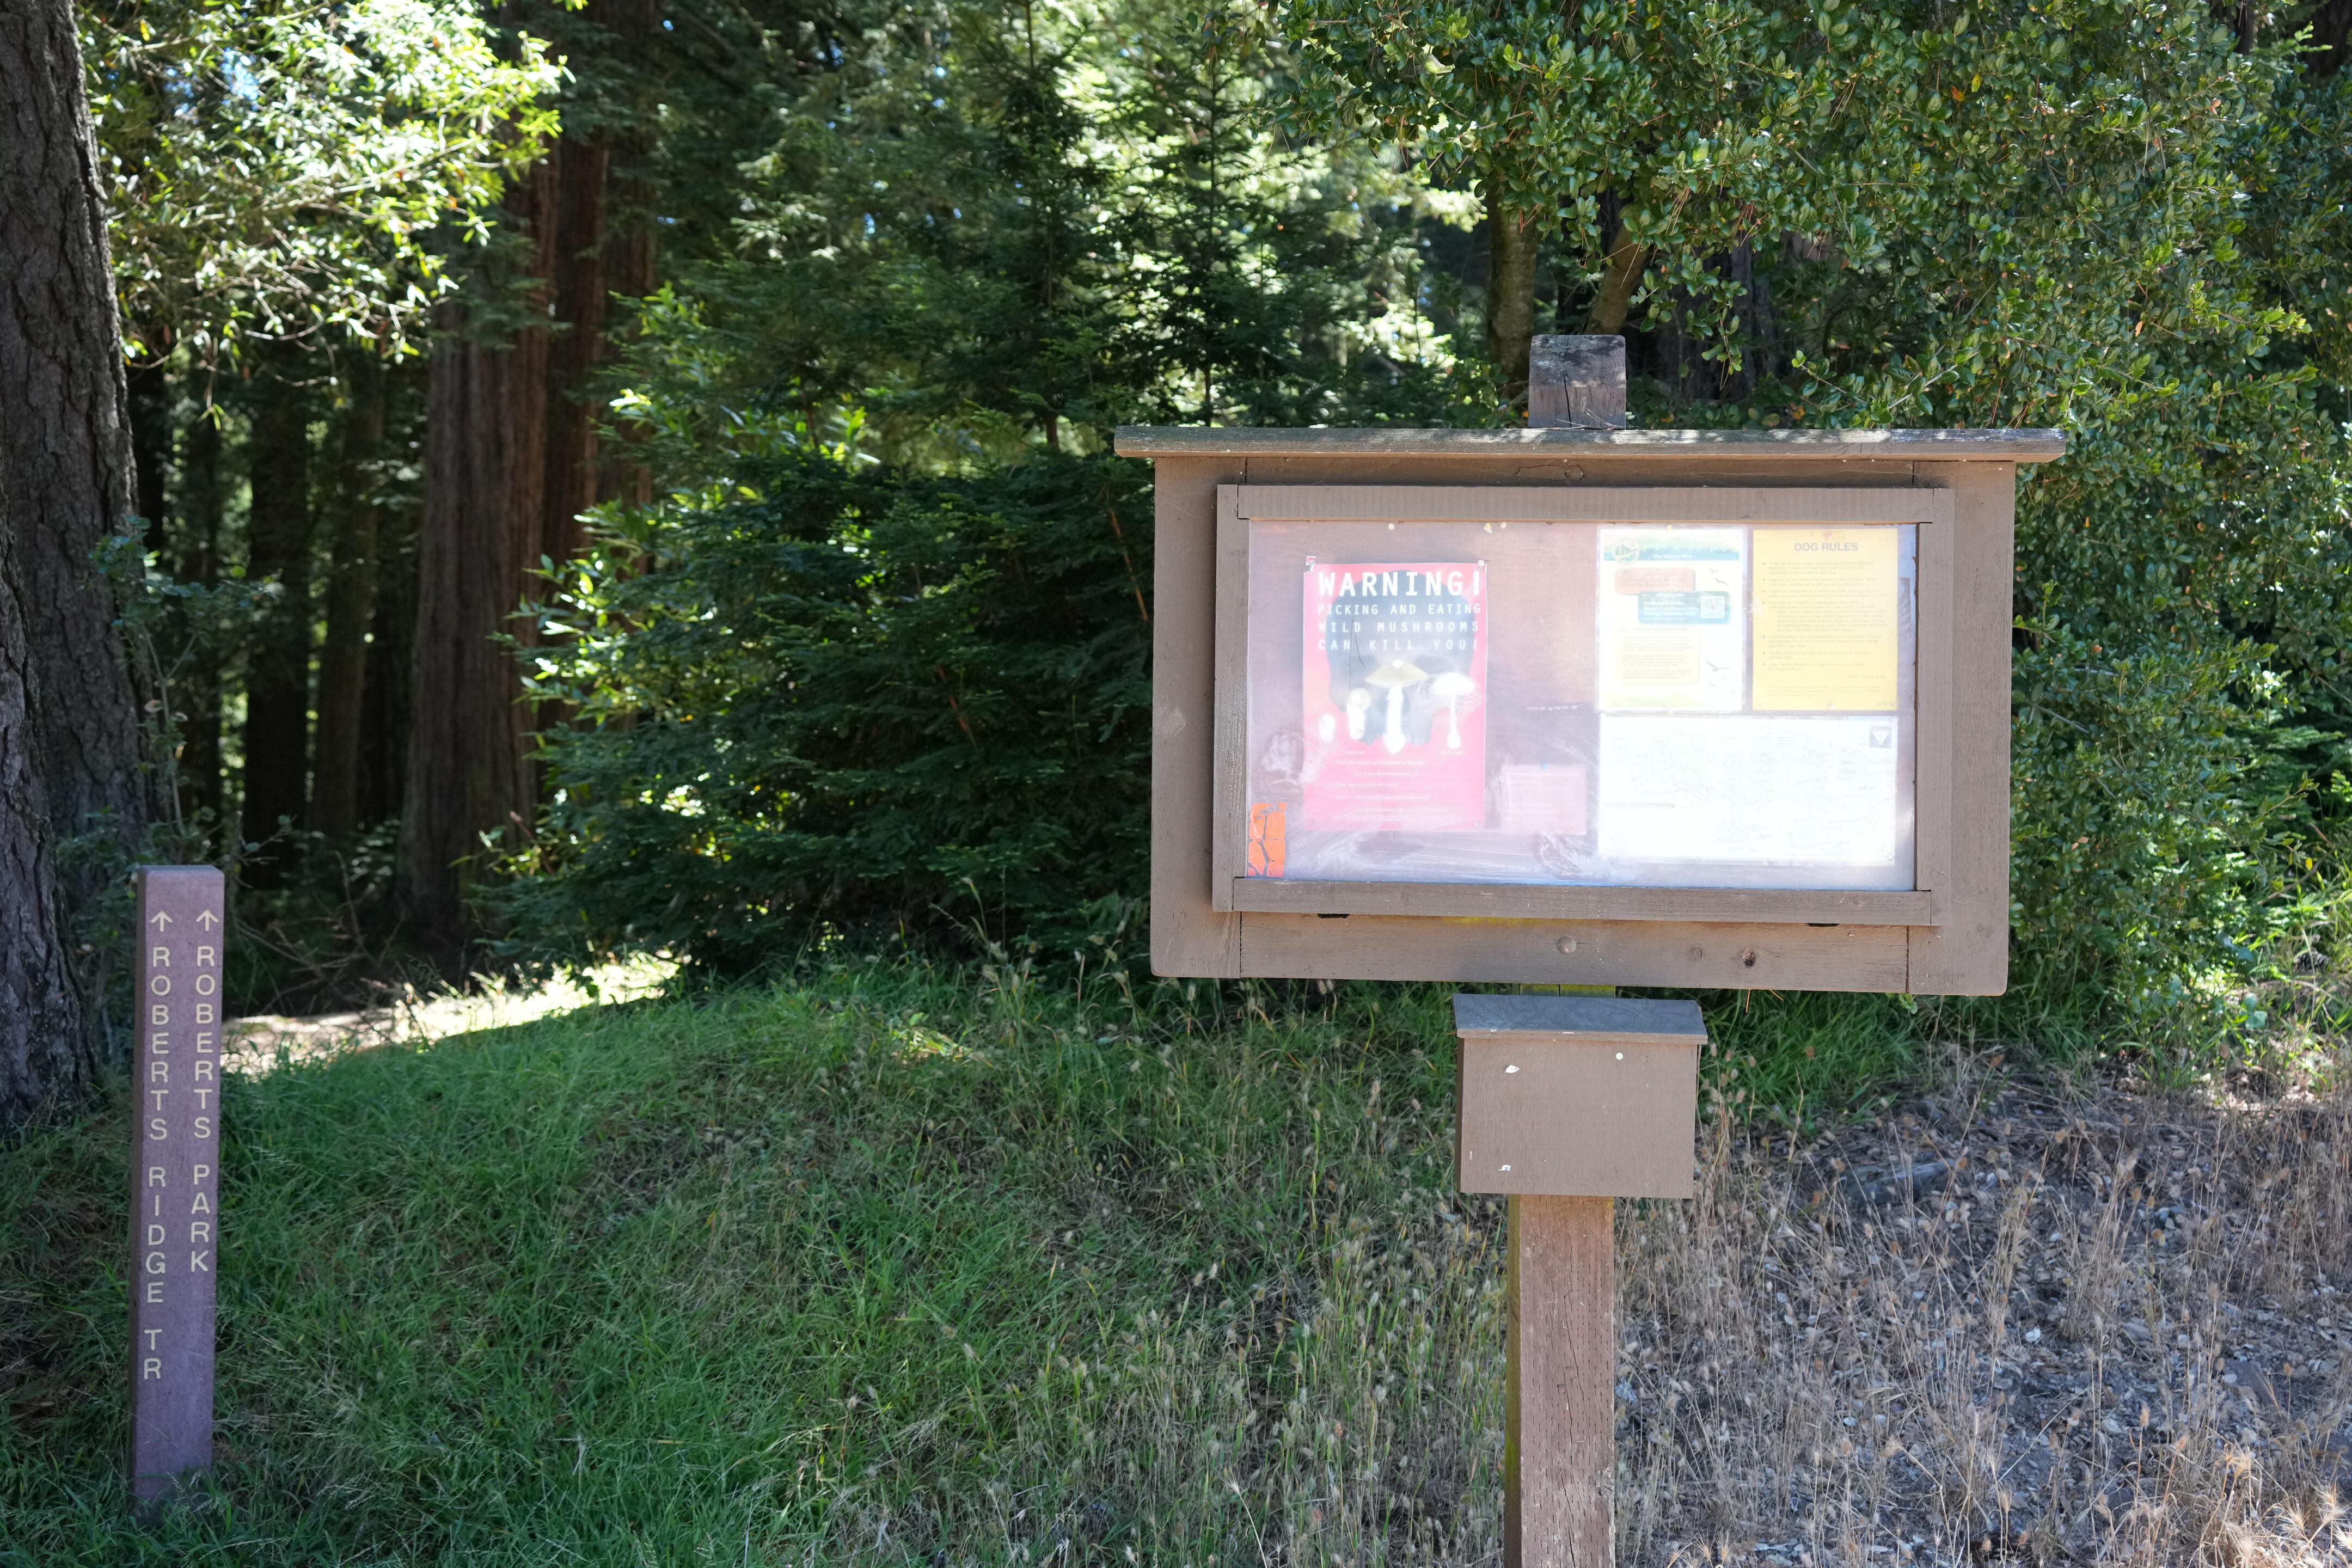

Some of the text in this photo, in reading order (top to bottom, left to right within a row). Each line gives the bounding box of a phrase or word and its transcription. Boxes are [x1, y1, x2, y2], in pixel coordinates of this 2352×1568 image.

[1794, 542, 1858, 552] DOG RULES
[1318, 571, 1480, 597] WARNING!
[1318, 604, 1480, 615] PICKING AND EATING
[1319, 622, 1479, 632] WILD MUSHROOMS
[1318, 639, 1478, 650] CAN KILL YOU!
[191, 945, 216, 1272] ROBERTS PARK
[144, 946, 171, 1380] ROBERTS RIDGE TR
